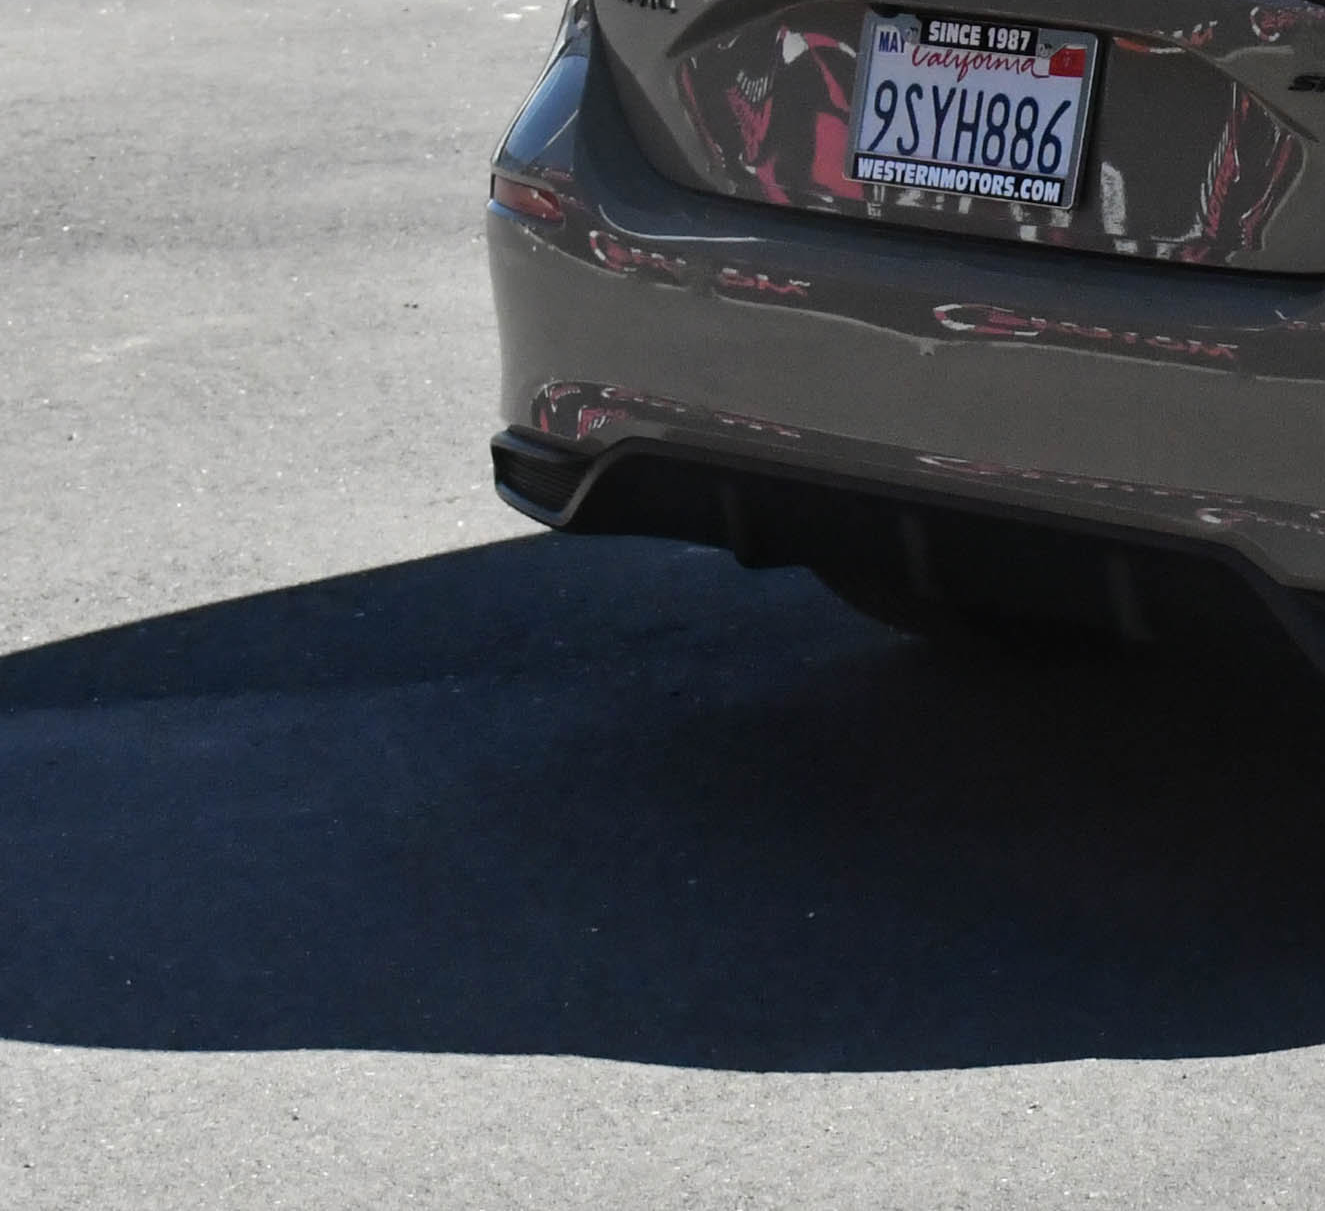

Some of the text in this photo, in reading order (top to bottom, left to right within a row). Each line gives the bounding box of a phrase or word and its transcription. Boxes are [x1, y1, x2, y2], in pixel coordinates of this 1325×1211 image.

[928, 20, 1031, 52] SINCE 1987
[911, 44, 1050, 83] California
[866, 78, 1072, 175] 9SYH886
[856, 156, 1062, 204] WESTERNMOTORS.COM
